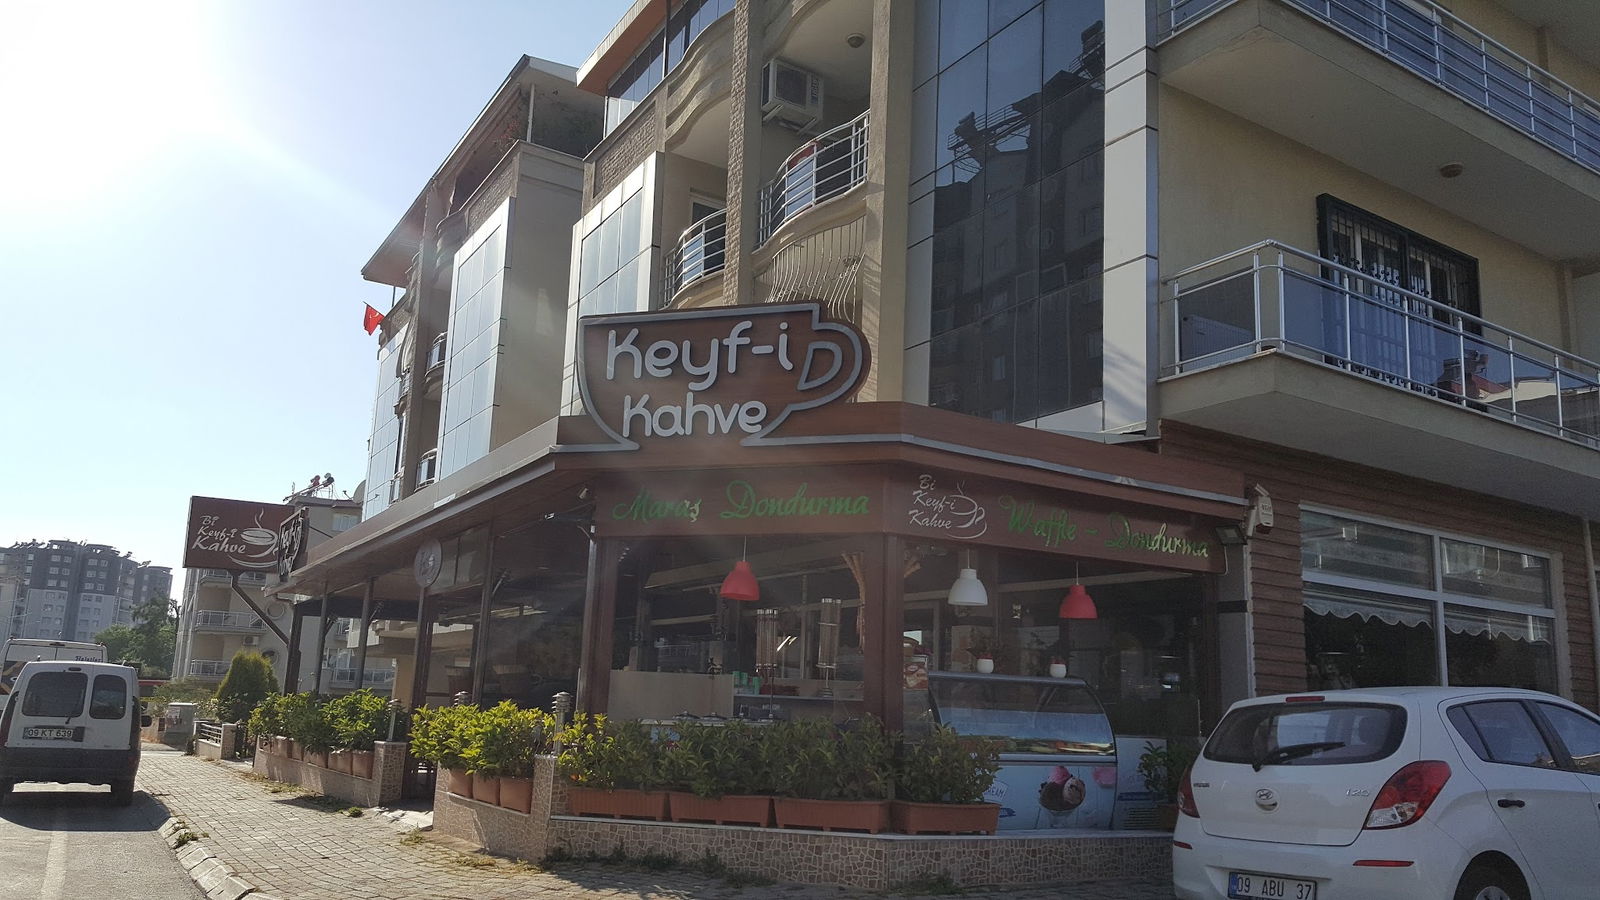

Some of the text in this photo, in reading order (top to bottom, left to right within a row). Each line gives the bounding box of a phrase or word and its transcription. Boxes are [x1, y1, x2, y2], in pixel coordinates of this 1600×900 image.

[606, 320, 794, 391] Keyf-i
[622, 391, 767, 438] Kahve
[919, 474, 936, 490] Bi
[720, 480, 870, 519] Dondurma
[912, 490, 956, 512] Keyf-i
[199, 515, 219, 526] Bi
[908, 509, 952, 529] Kahve
[999, 495, 1078, 547] Waffle
[1104, 511, 1209, 558] Dondurma
[197, 525, 238, 540] Keyf-i
[192, 535, 246, 554] Kahve
[28, 729, 39, 737] 09
[41, 729, 54, 737] KT
[1237, 876, 1312, 900] 09 ABU 37
